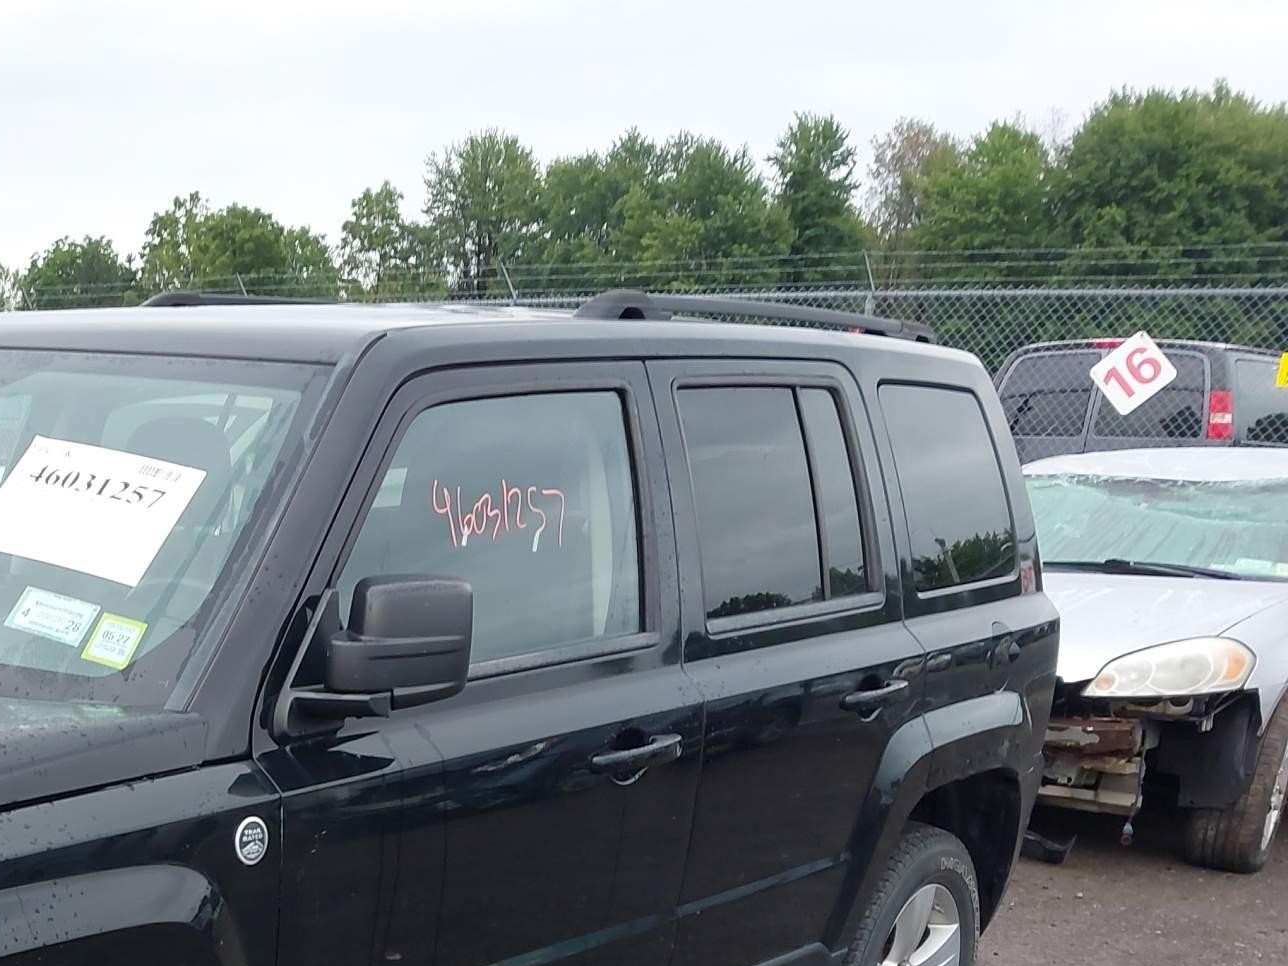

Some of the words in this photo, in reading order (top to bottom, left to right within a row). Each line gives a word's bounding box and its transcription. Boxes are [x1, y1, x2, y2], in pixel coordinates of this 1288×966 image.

[1103, 347, 1162, 399] 16
[29, 464, 167, 509] 46031257
[432, 479, 565, 552] 46031257
